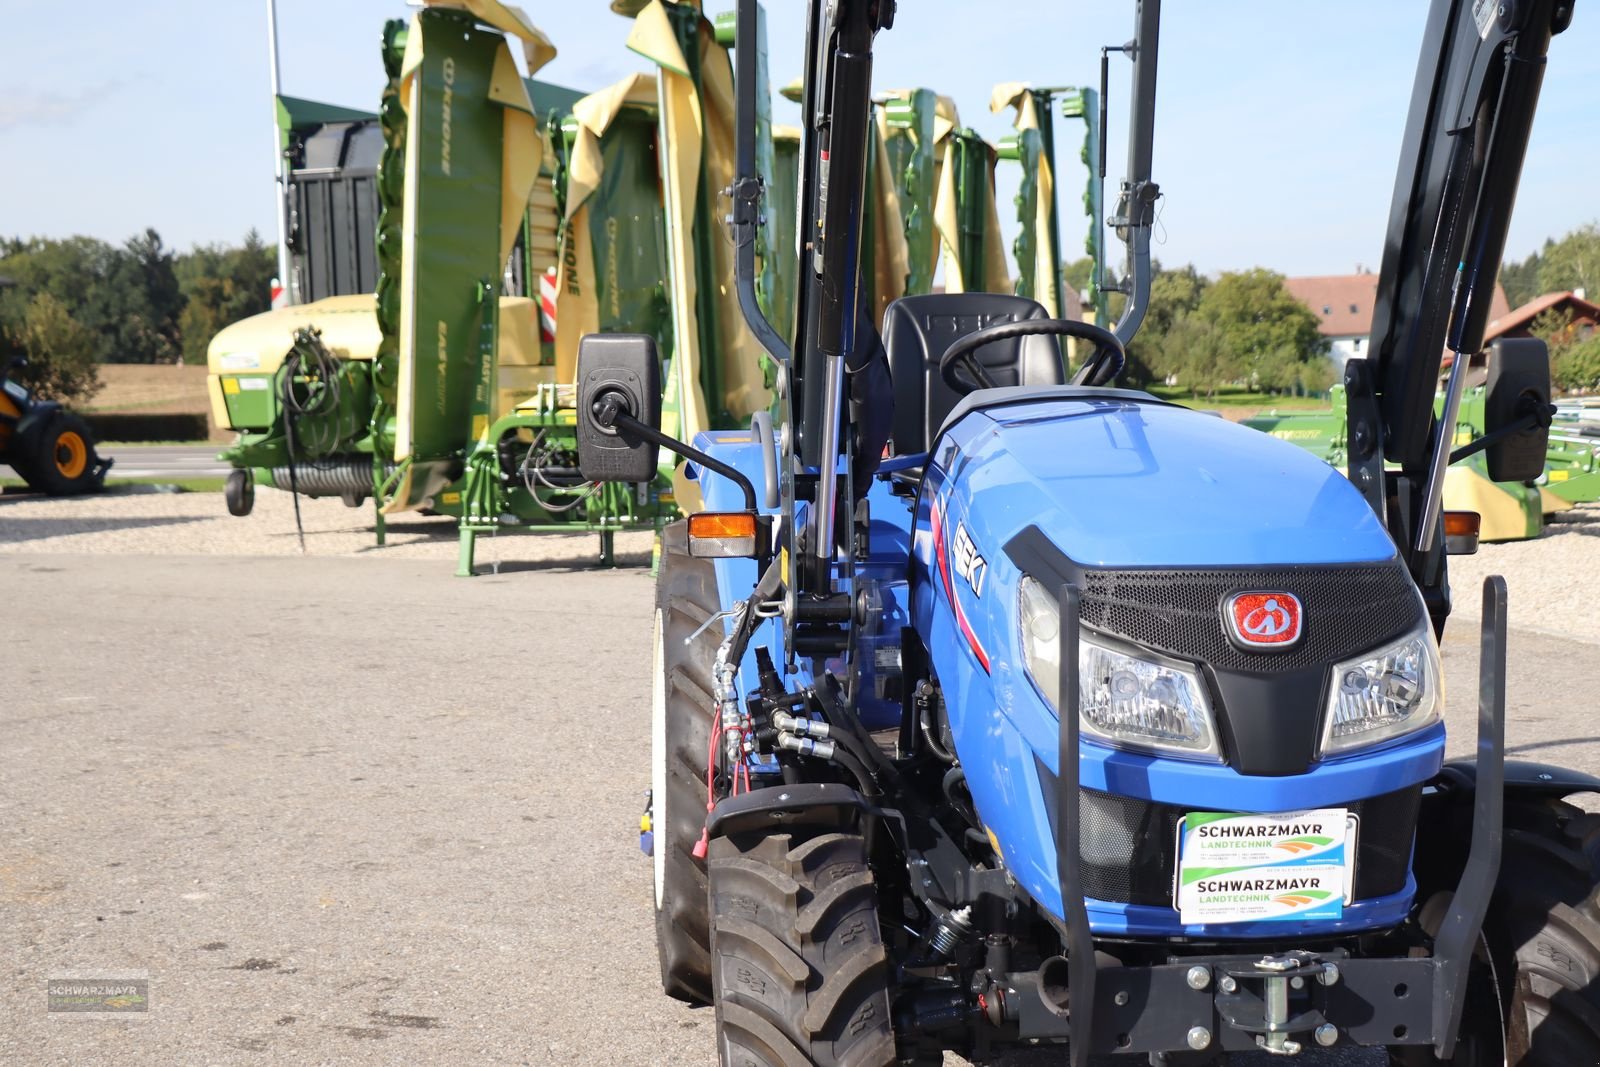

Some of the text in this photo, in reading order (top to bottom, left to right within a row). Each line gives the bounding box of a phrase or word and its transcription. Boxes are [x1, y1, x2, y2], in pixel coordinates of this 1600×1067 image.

[442, 83, 453, 177] KRONE
[1199, 823, 1322, 838] SCHWARZMAYR
[1200, 839, 1273, 849] LANDTECHNIK
[1197, 878, 1320, 893] SCHWARZMAYR
[1199, 894, 1271, 903] LANDTECHNIK
